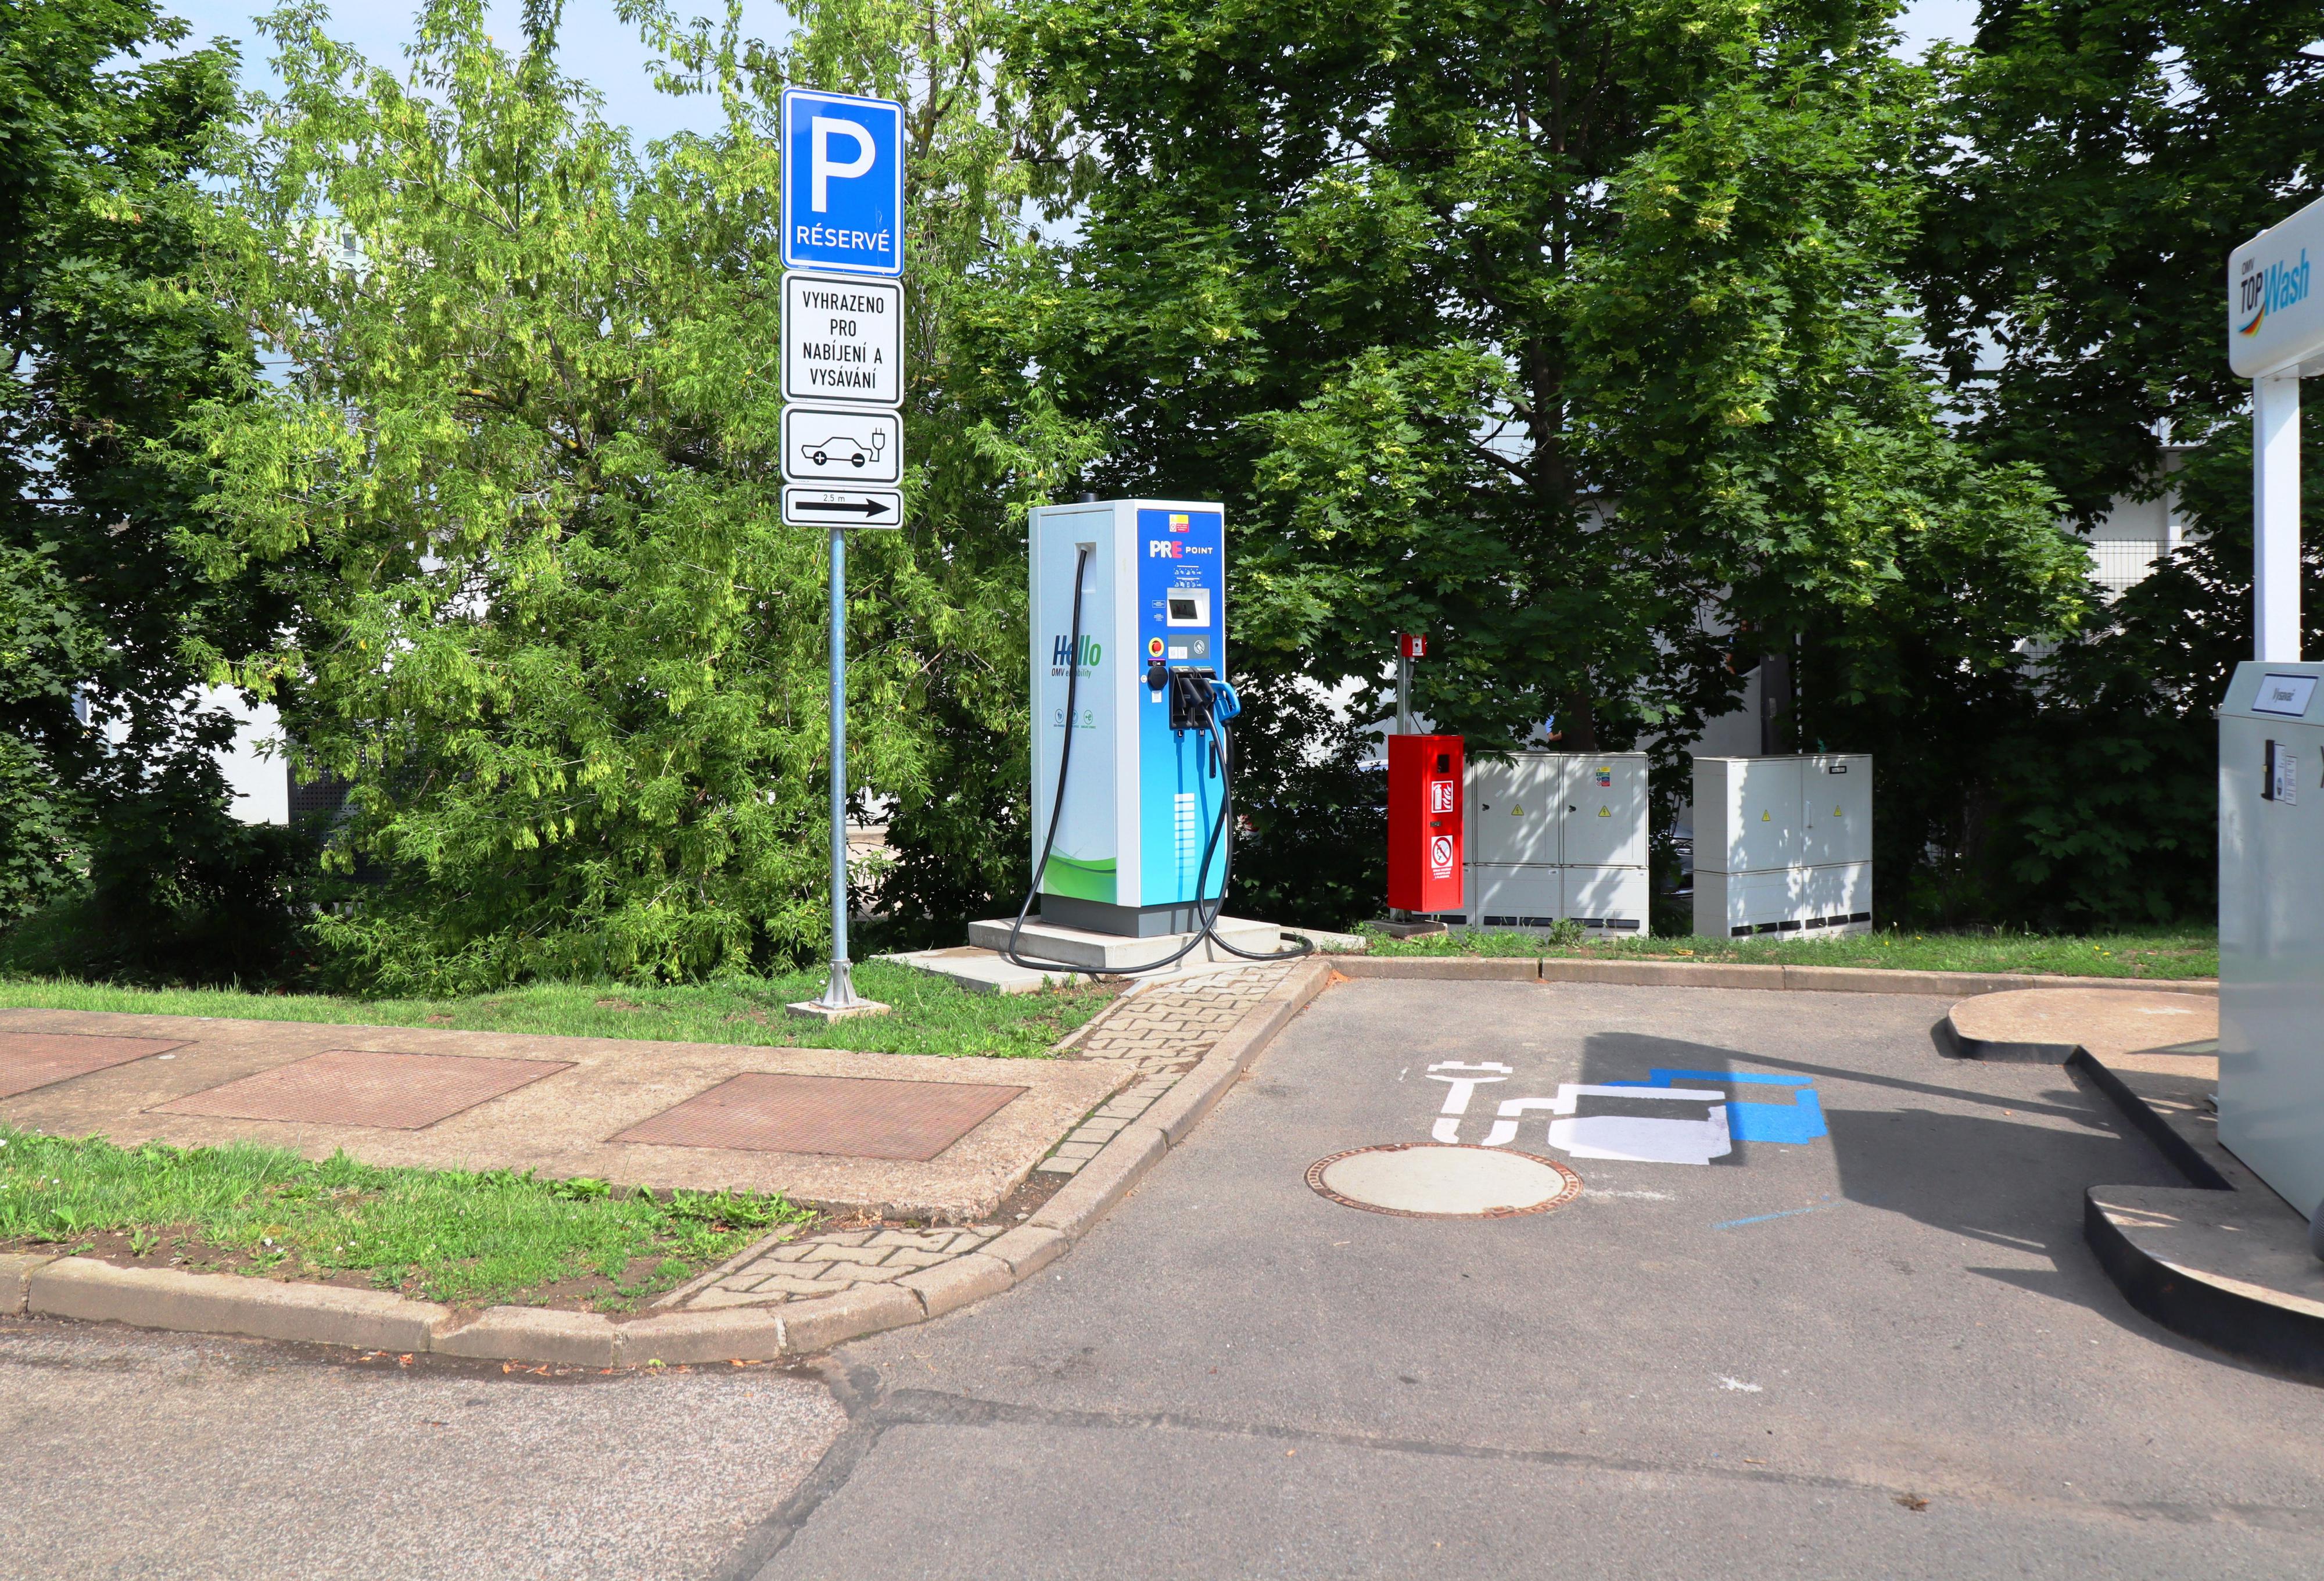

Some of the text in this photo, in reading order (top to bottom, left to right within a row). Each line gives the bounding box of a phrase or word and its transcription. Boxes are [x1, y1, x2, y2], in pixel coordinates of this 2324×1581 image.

[812, 116, 876, 213] P
[797, 223, 890, 252] RÉSERVÉ
[802, 291, 884, 314] VYHRAZENO
[830, 318, 856, 336] PRO
[803, 339, 883, 364] NABÍJENÍ A
[810, 365, 876, 389] VYSÁVÁNÍ
[1150, 540, 1213, 558] PRE POINT
[1051, 668, 1065, 677] OMV
